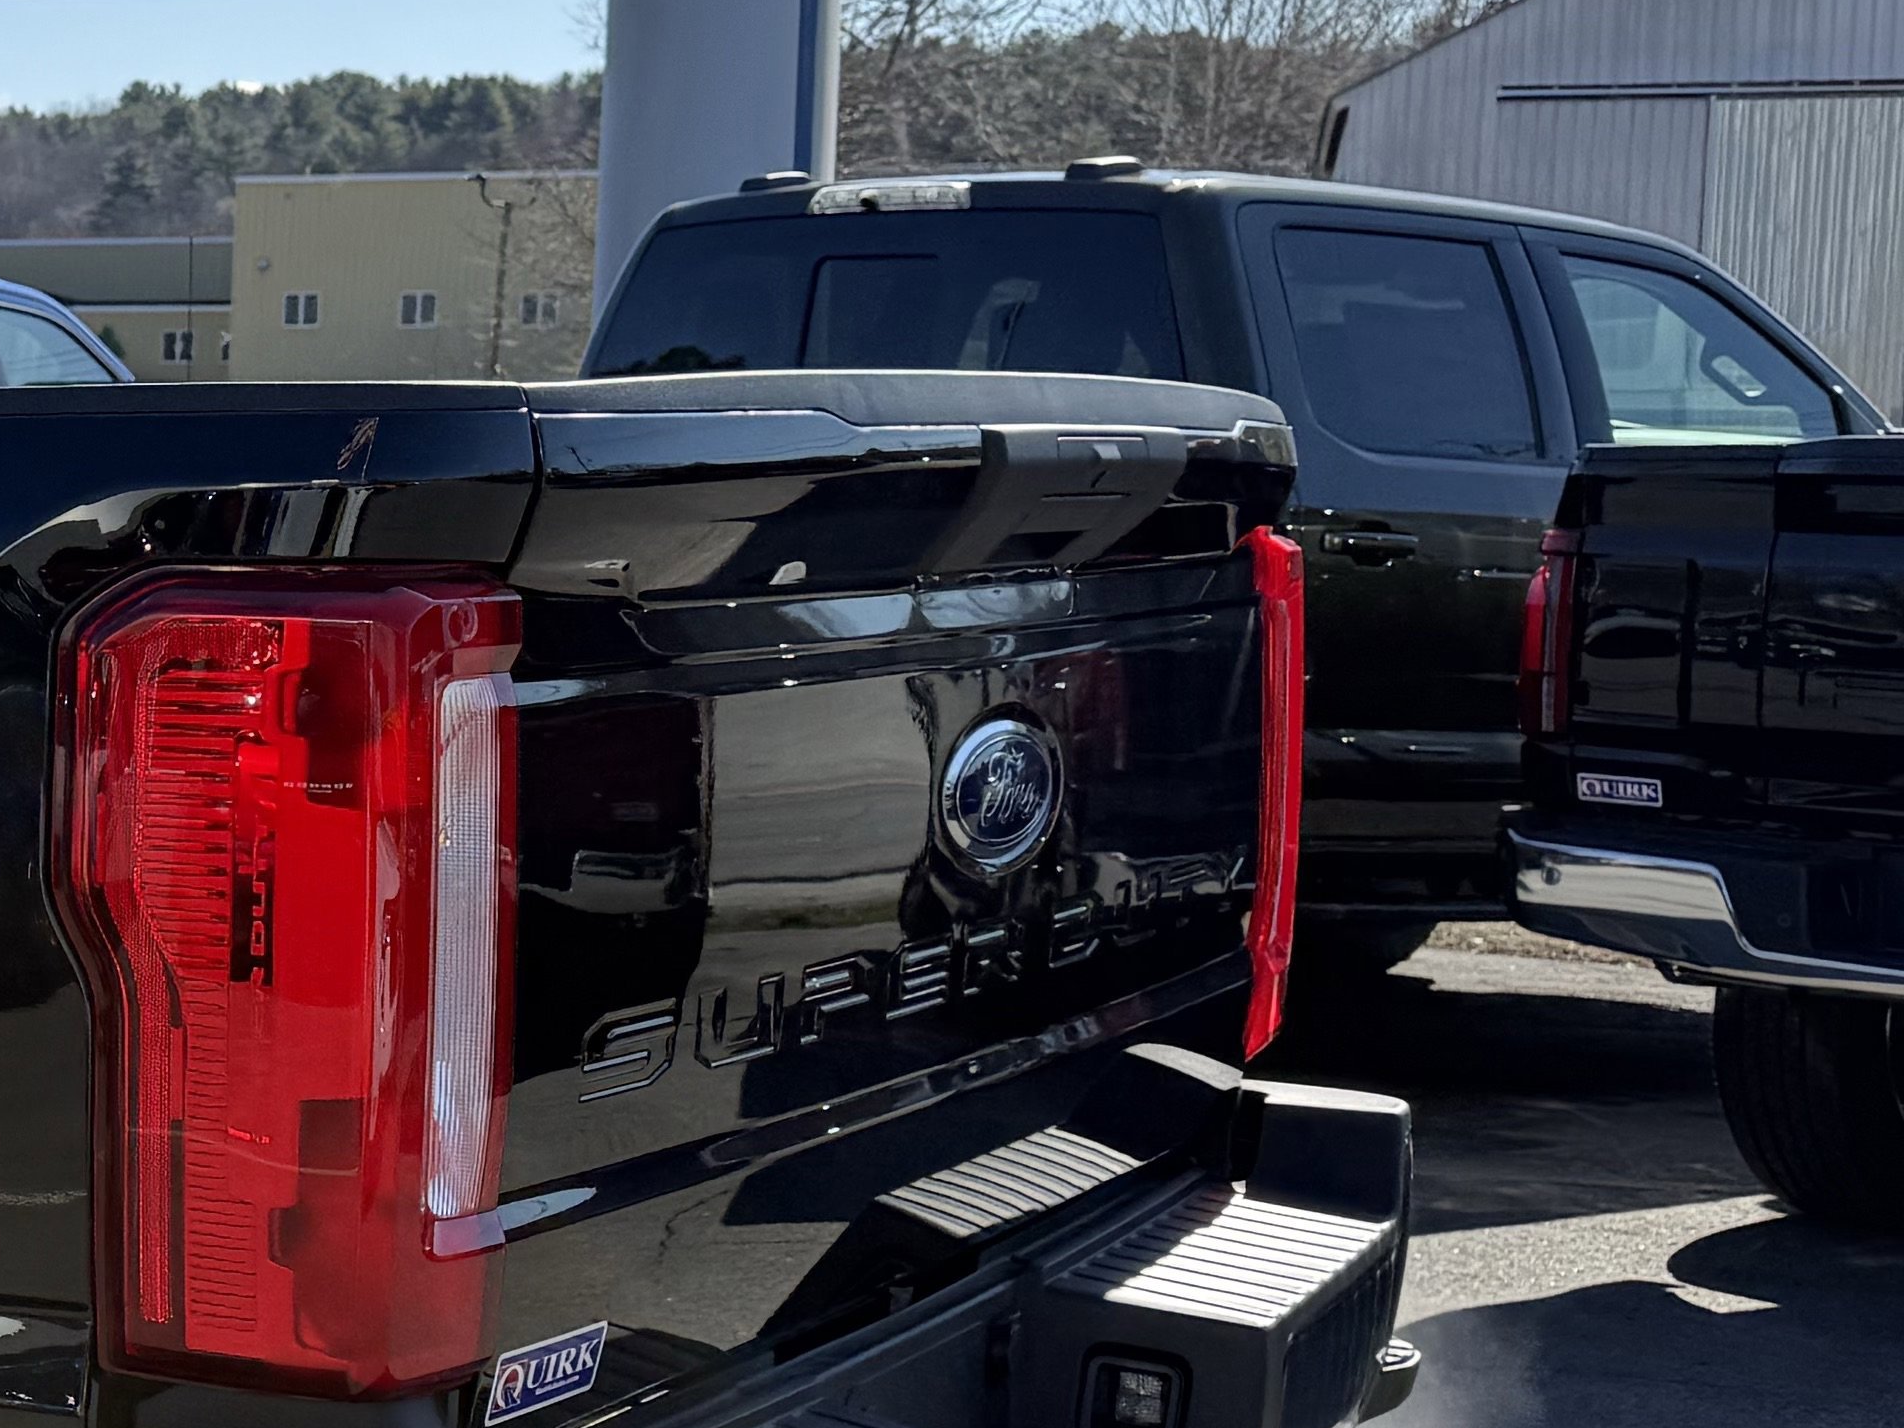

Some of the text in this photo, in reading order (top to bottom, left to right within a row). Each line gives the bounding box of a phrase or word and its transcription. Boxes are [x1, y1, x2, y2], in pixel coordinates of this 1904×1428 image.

[1581, 778, 1657, 799] QUIRK
[578, 917, 1024, 1104] SUPER
[495, 1338, 601, 1409] QUIRK
